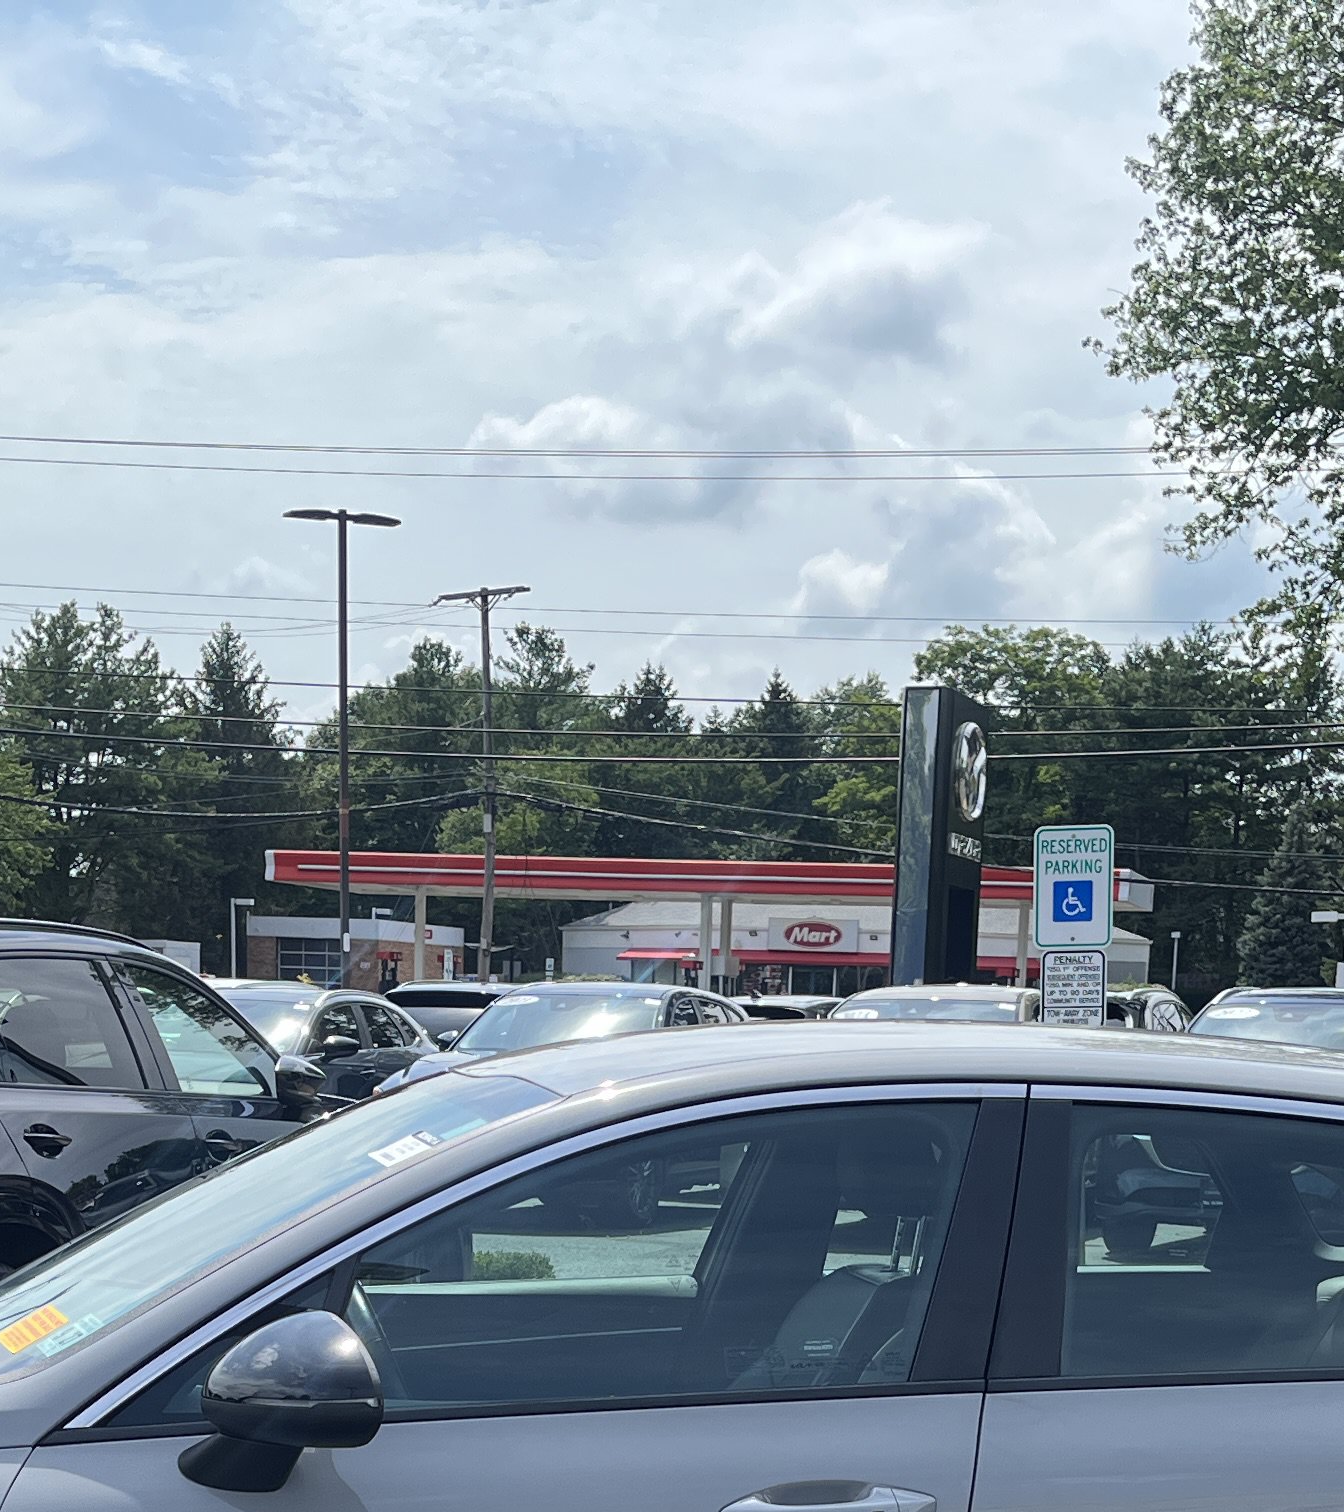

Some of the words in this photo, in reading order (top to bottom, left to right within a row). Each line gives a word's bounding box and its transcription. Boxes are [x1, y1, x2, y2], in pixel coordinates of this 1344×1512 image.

[1041, 838, 1107, 854] RESERVED
[1044, 858, 1103, 875] PARKING
[788, 926, 838, 943] Mart
[1053, 955, 1093, 964] PENALTY
[1082, 1009, 1099, 1017] ZONE
